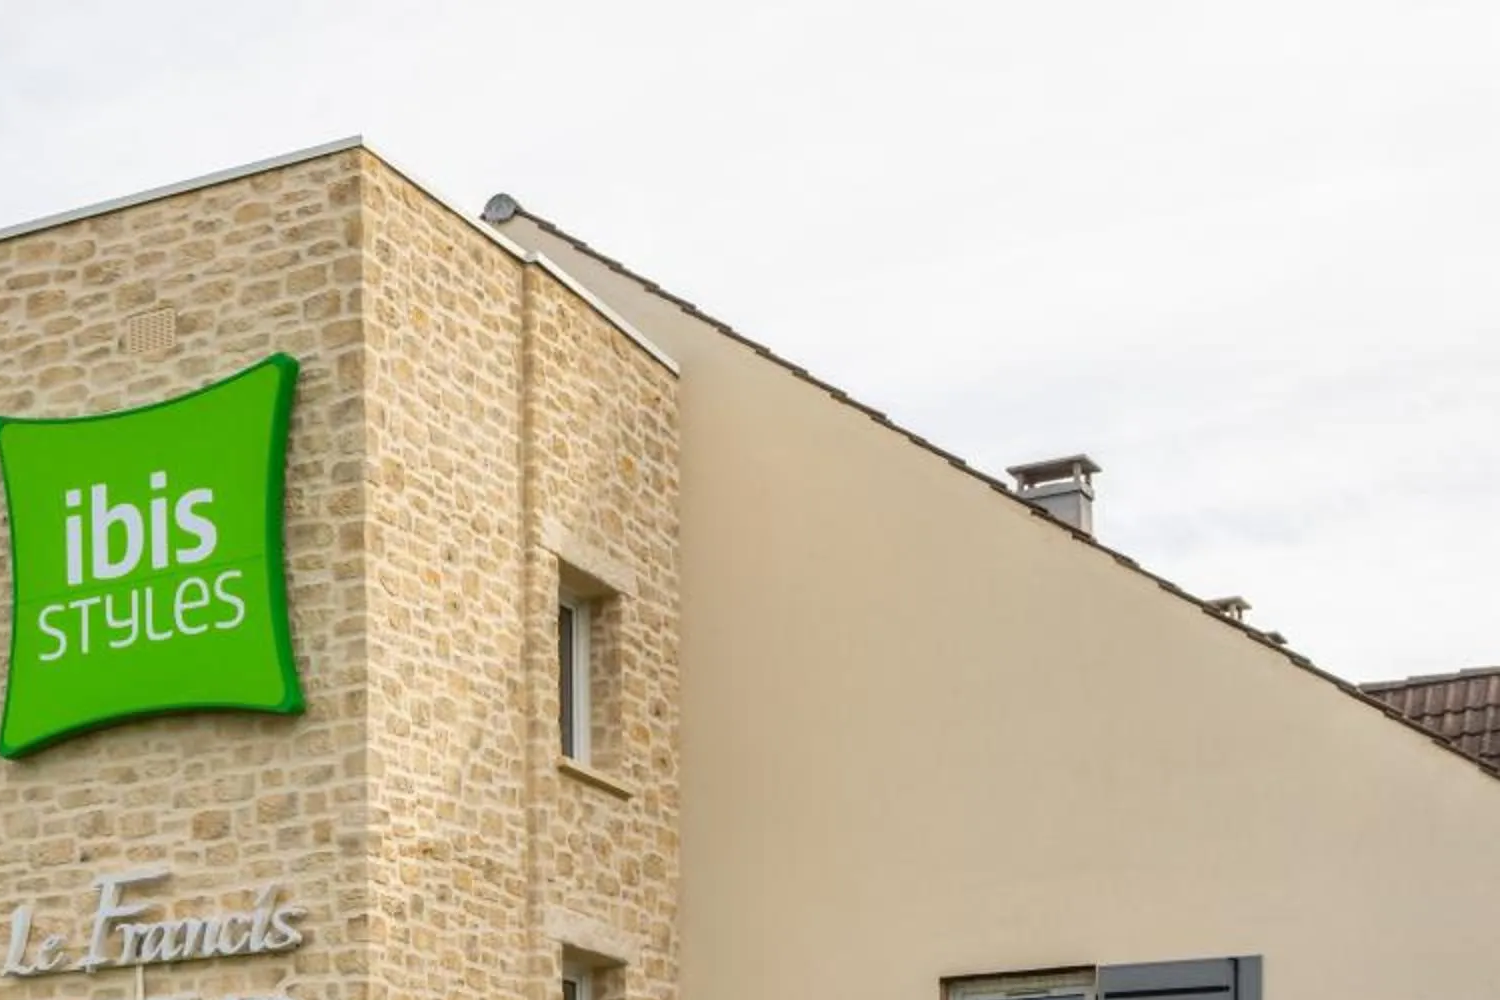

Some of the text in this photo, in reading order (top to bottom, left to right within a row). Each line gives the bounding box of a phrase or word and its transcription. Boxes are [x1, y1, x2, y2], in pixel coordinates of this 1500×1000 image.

[66, 472, 217, 586] ibis
[1, 865, 307, 976] Le Francis
